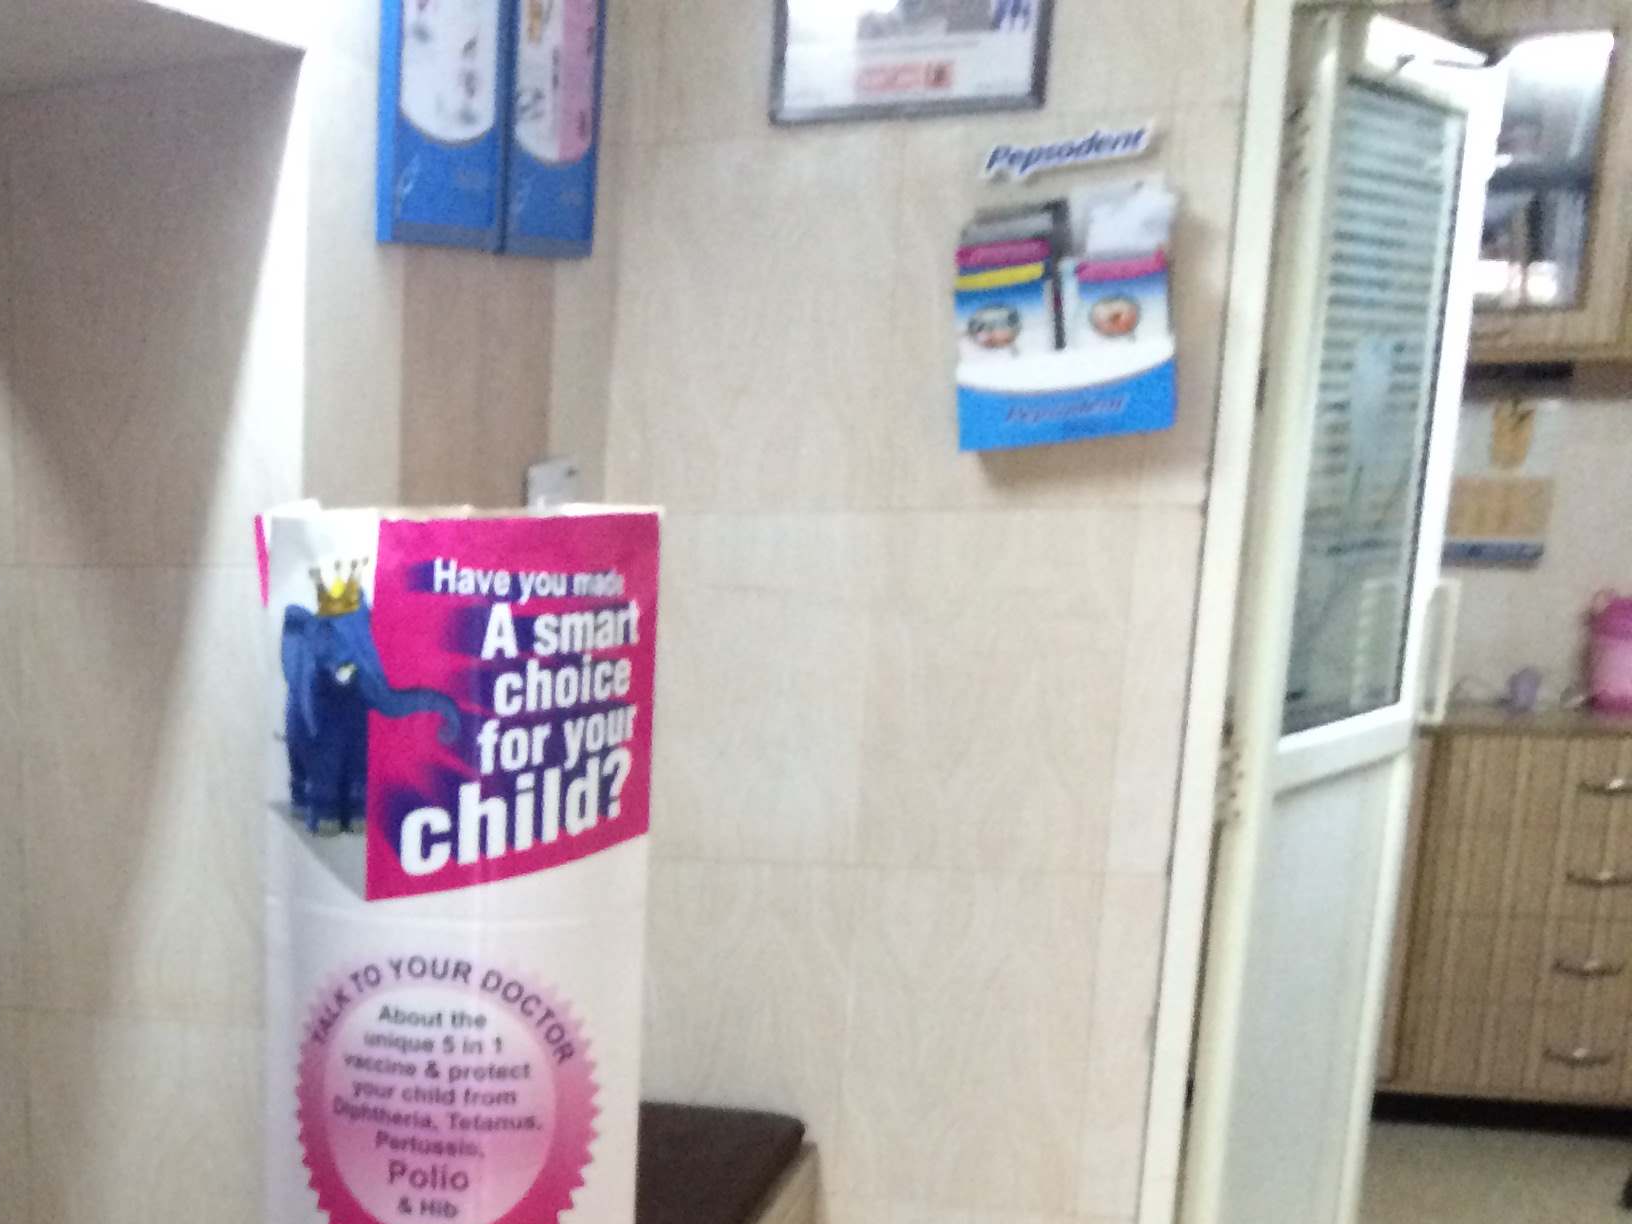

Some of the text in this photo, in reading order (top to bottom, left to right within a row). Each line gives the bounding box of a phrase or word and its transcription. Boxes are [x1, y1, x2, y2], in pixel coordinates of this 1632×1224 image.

[985, 128, 1144, 175] Pepsodent
[433, 557, 509, 597] Have
[518, 570, 567, 604] you
[480, 600, 640, 661] A smart
[493, 656, 632, 717] choice
[477, 703, 638, 775] for your
[399, 749, 634, 878] child?
[311, 955, 576, 1065] TALK TO YOUR DOCTOR
[378, 1003, 488, 1030] About the
[363, 1030, 435, 1055] unique
[442, 1034, 456, 1055] 5
[462, 1036, 484, 1055] in
[344, 1053, 532, 1083] vaccine & protect
[351, 1080, 517, 1106] your child from
[388, 1158, 470, 1191] Polio
[397, 1196, 459, 1219] & Hib
